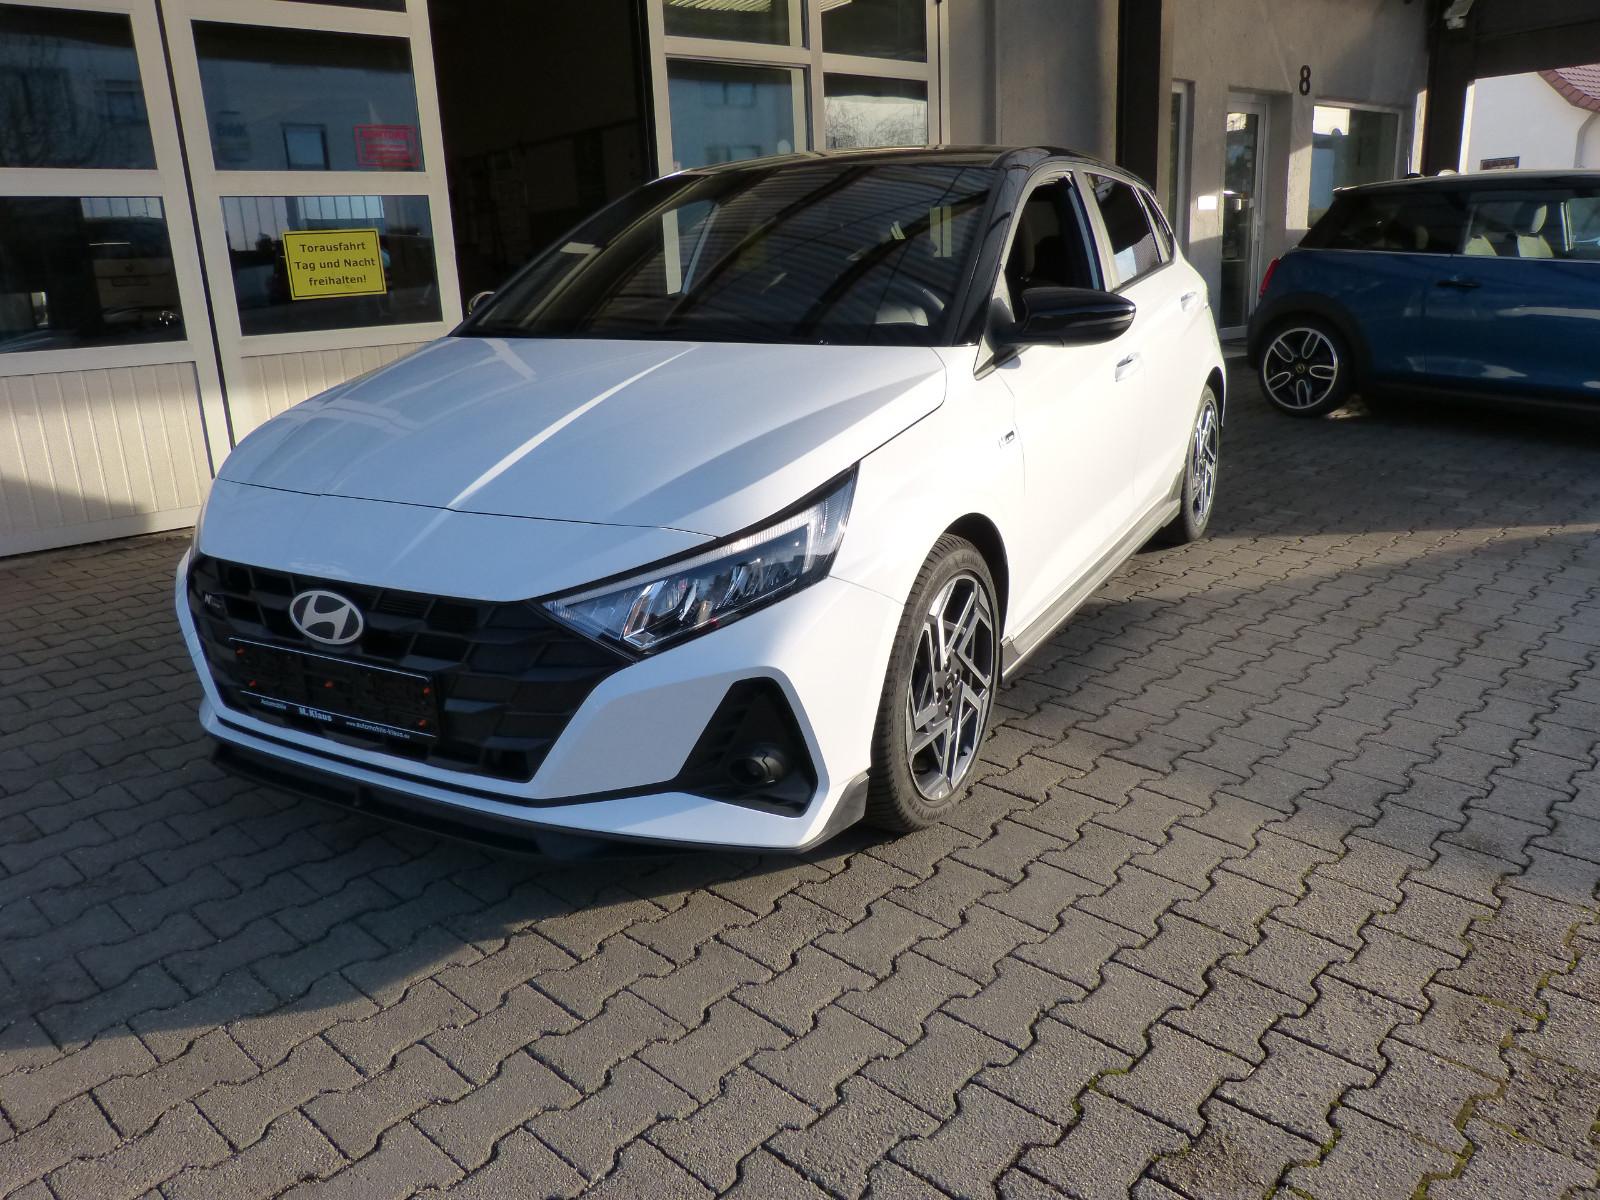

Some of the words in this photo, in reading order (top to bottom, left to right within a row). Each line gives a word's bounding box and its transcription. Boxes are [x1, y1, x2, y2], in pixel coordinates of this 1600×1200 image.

[1299, 65, 1311, 97] 8
[299, 242, 366, 252] Torausfahrt
[294, 261, 316, 271] Tag
[319, 259, 340, 268] und
[344, 258, 376, 267] Nacht
[308, 275, 366, 286] freihalten!
